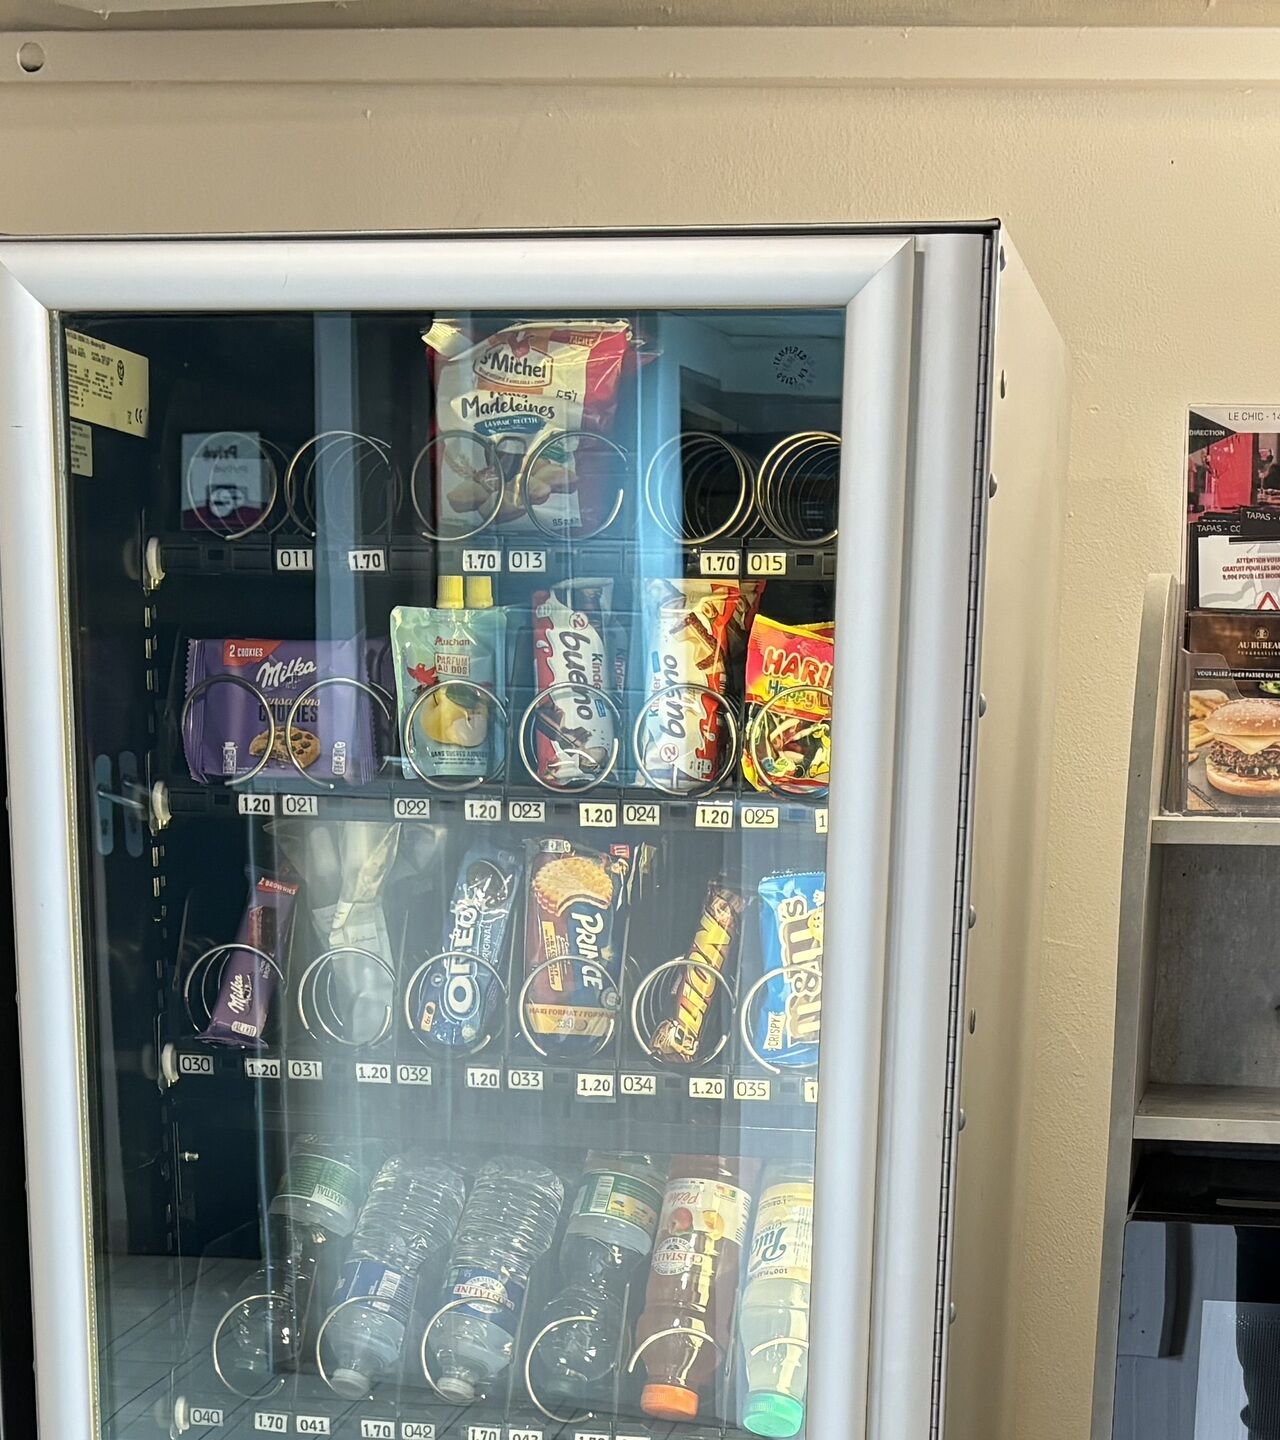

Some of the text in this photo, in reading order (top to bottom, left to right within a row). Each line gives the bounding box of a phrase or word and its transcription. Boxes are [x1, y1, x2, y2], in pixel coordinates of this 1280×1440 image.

[490, 352, 548, 379] Michel
[461, 396, 556, 420] Madeleines
[1228, 412, 1240, 422] LE
[1242, 412, 1264, 422] CHIC
[1246, 512, 1270, 522] TAPAS
[280, 551, 382, 570] 011 1.70
[466, 552, 783, 572] 1.70 013 1.70 015
[434, 636, 470, 646] Auchan
[1238, 642, 1250, 650] AU
[229, 644, 264, 658] 2 COOKIES
[256, 656, 317, 688] Milka
[242, 797, 776, 825] 1.20 021 022 1.20 023 1.20 024 1.20 025
[767, 1018, 781, 1048] CRISPY
